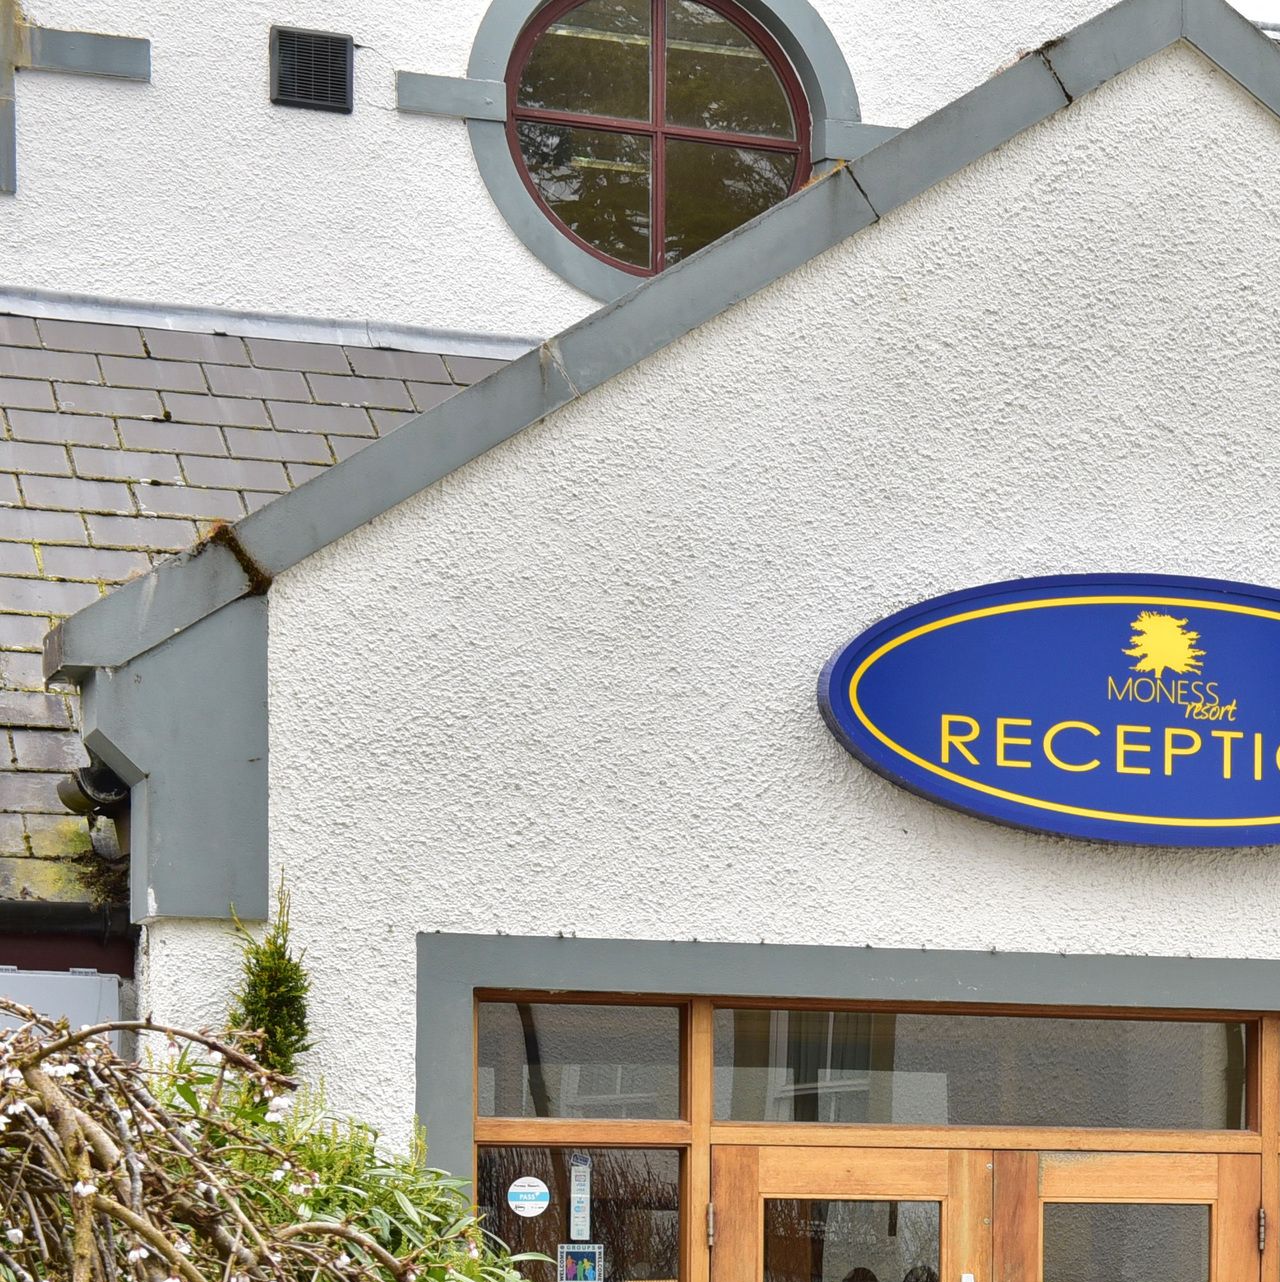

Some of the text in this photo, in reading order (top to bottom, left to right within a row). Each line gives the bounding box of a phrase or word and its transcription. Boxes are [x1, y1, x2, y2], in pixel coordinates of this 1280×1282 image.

[1107, 676, 1219, 707] MONESS
[1184, 698, 1238, 724] resort
[519, 1193, 536, 1201] PASS
